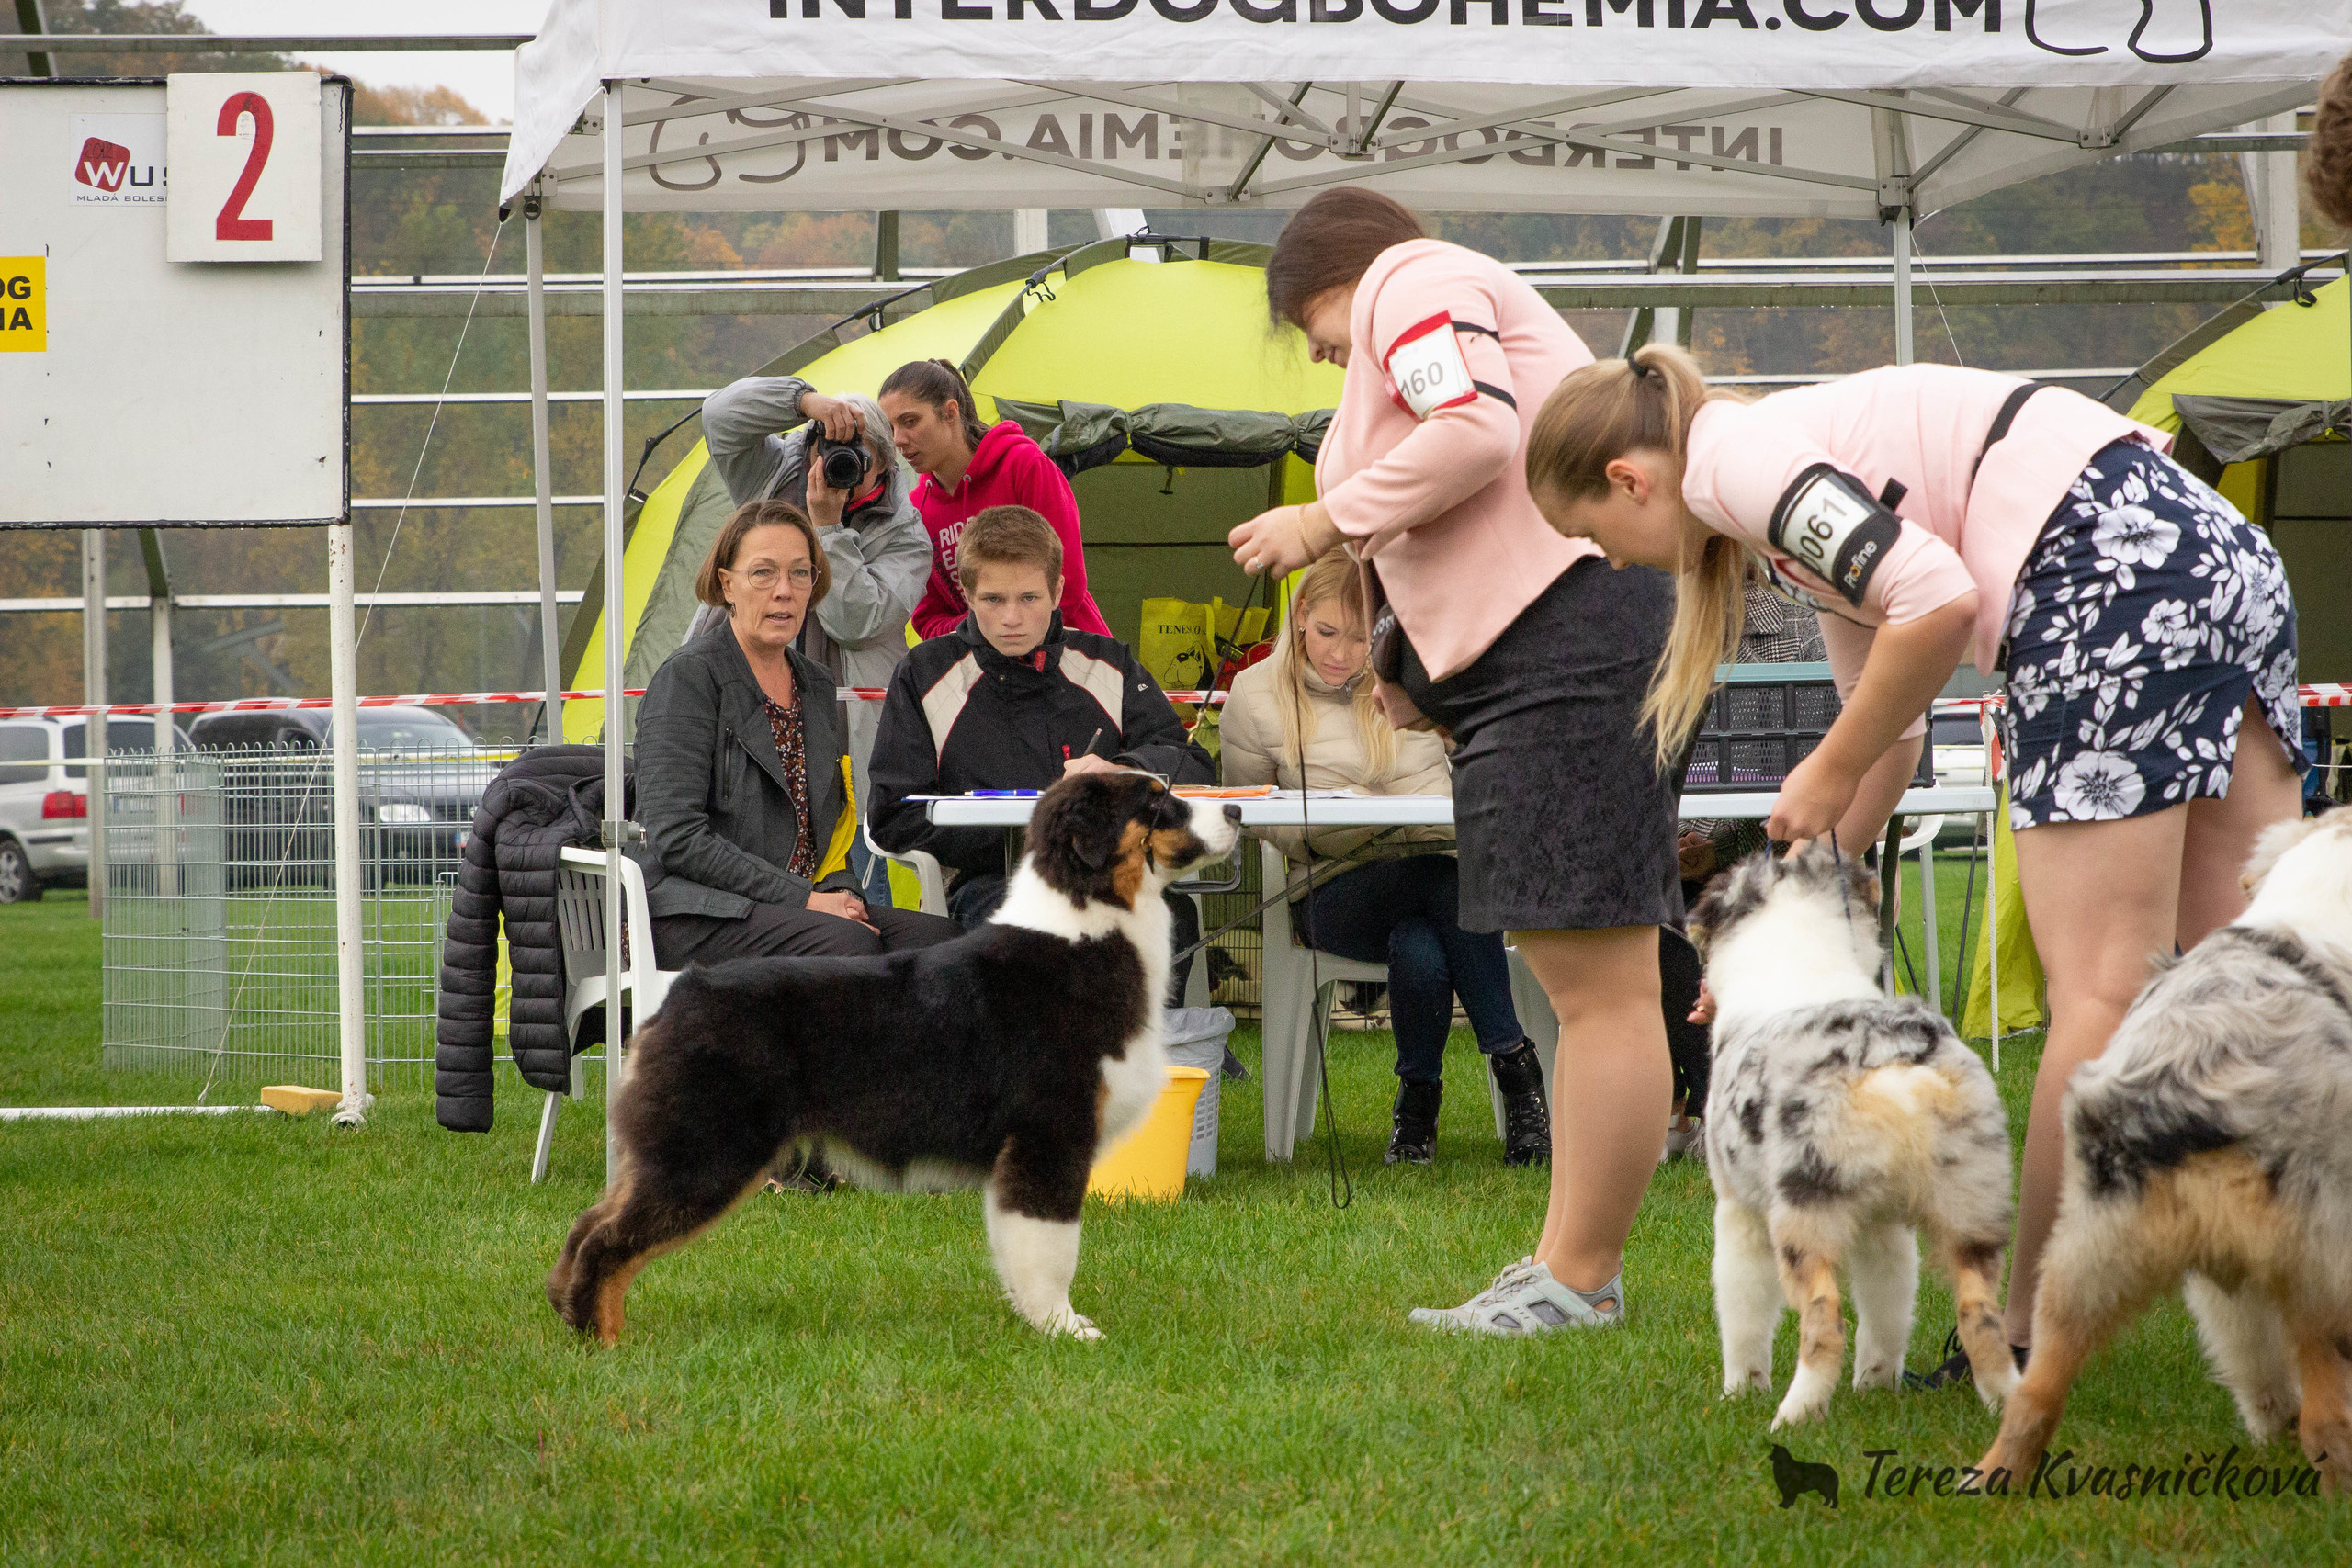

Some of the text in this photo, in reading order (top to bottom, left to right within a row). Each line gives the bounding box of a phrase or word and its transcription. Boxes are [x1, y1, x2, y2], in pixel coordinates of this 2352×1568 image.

[84, 161, 167, 187] WU
[216, 91, 274, 241] 2
[76, 194, 119, 202] MLADÁ
[0, 276, 31, 300] G
[938, 516, 975, 548] RID
[1843, 540, 1878, 589] Profine
